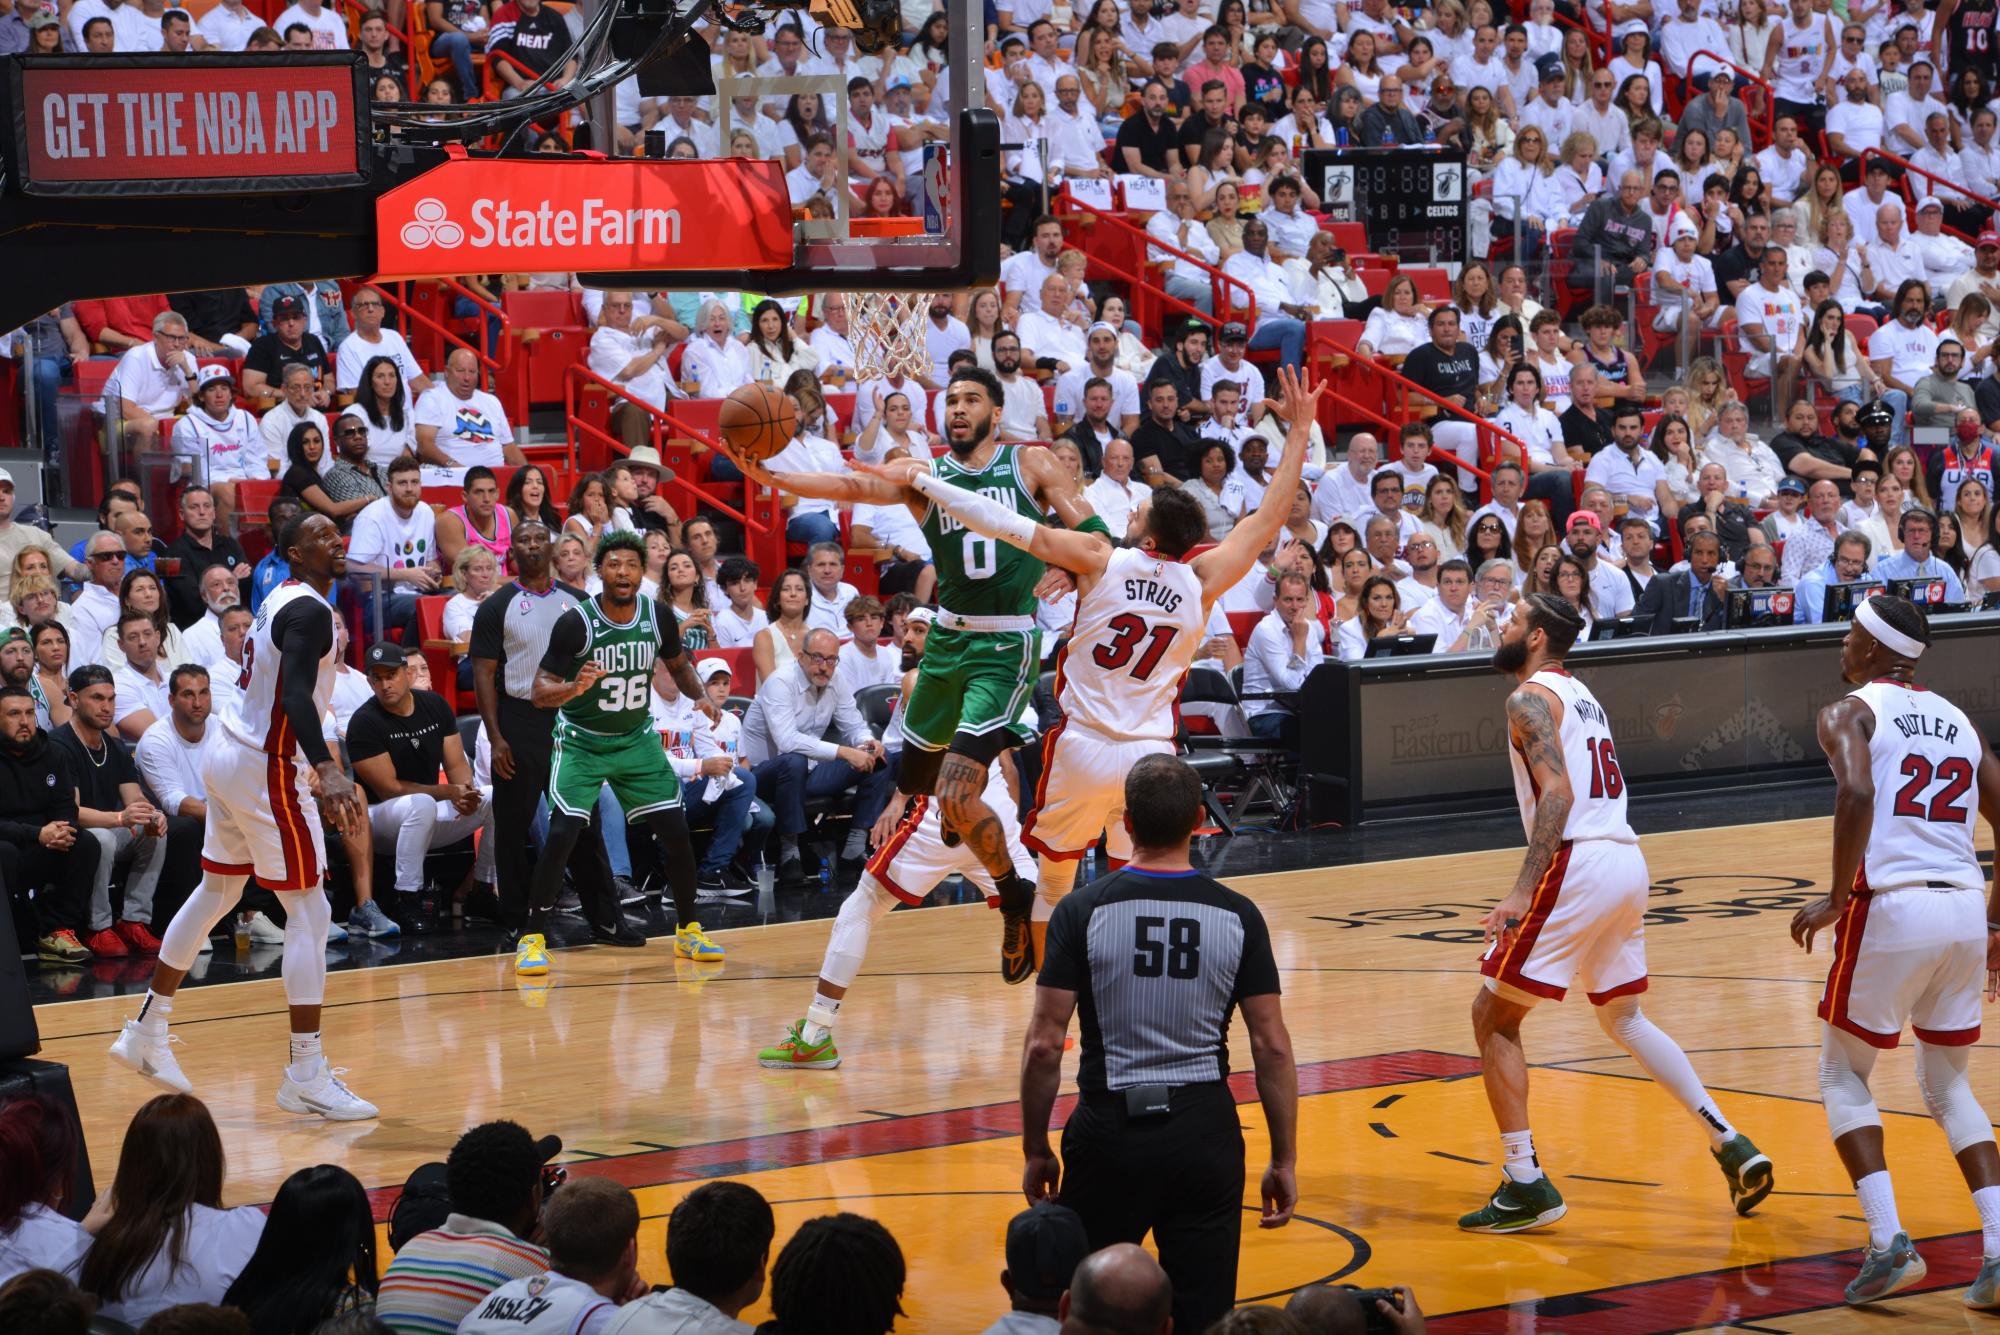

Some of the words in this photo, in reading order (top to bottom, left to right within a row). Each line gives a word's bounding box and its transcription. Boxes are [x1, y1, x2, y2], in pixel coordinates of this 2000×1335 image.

[516, 32, 553, 49] HEAT
[1966, 28, 1988, 53] 10
[43, 93, 109, 159] GET
[117, 92, 188, 157] THE
[195, 91, 267, 156] NBA
[274, 90, 338, 153] APP
[1332, 208, 1349, 220] HEA
[1426, 205, 1459, 218] CELTICS
[962, 531, 997, 580] 0
[1125, 578, 1183, 613] STRUS
[593, 641, 656, 674] BOSTON
[1092, 612, 1179, 681] 31
[598, 673, 648, 712] 36
[1574, 698, 1606, 728] MARTIN
[1893, 713, 1959, 745] BUTLER
[1390, 718, 1474, 761] Eastern
[1586, 736, 1624, 800] 16
[1893, 752, 1974, 824] 22
[1133, 915, 1201, 980] 58
